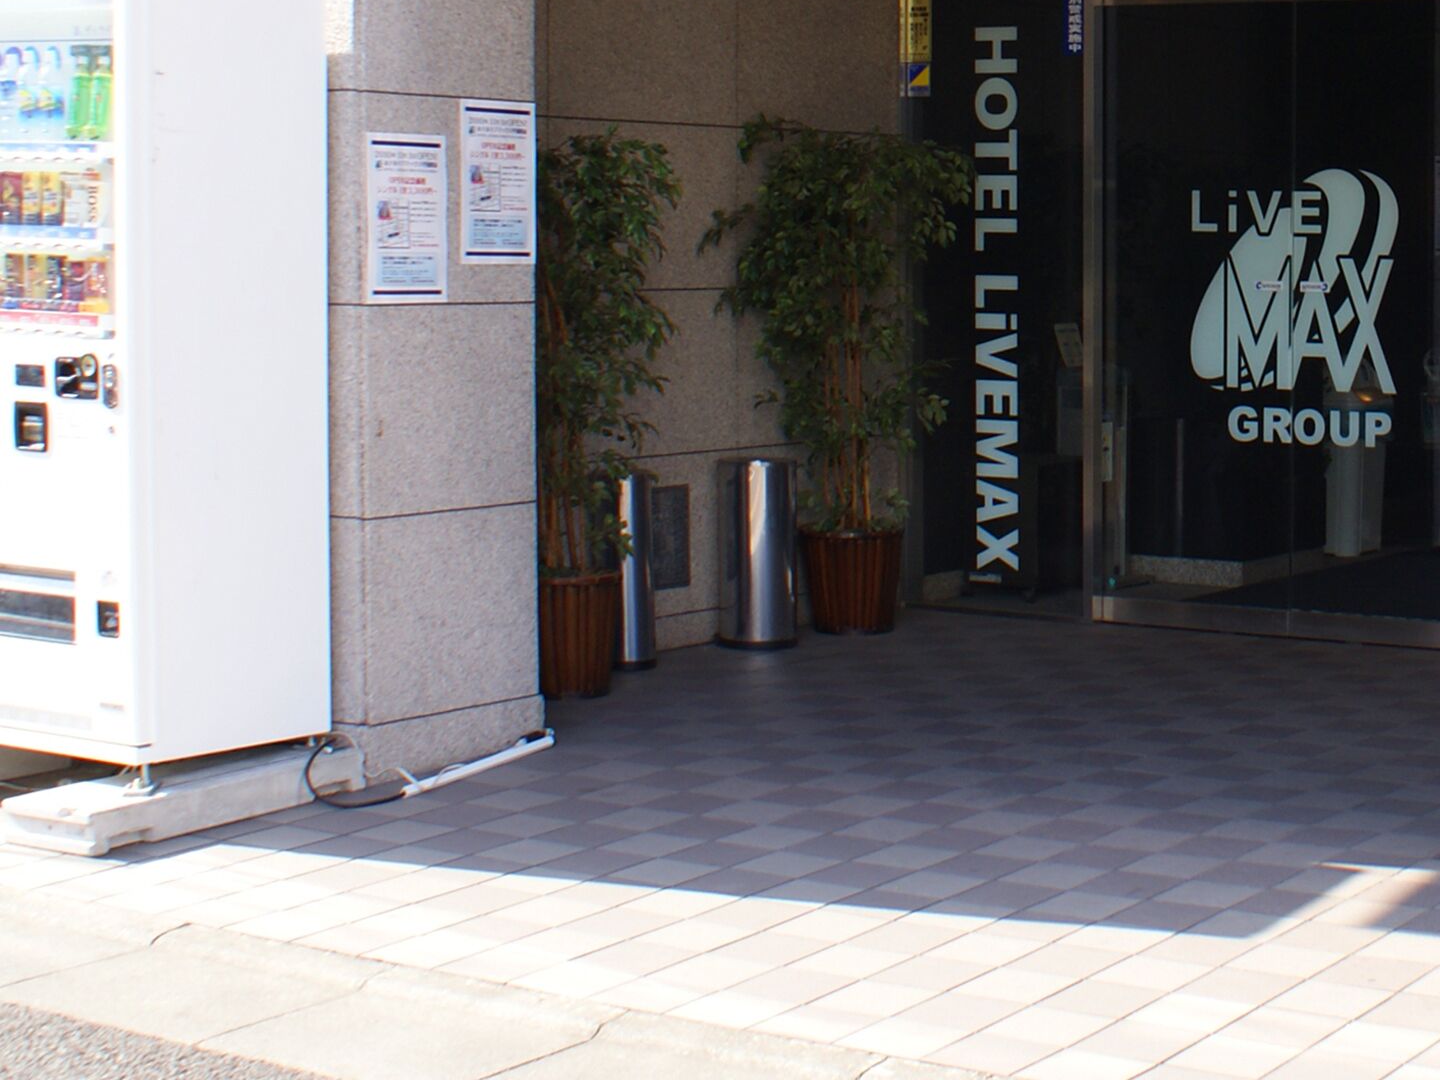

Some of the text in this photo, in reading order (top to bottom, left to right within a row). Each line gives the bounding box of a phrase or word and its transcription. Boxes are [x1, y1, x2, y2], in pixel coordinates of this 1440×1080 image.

[1190, 189, 1323, 234] LiVE
[973, 25, 1021, 572] HOTEL LiVEMAX
[1225, 256, 1398, 395] MAX
[1227, 405, 1393, 448] GROUP
